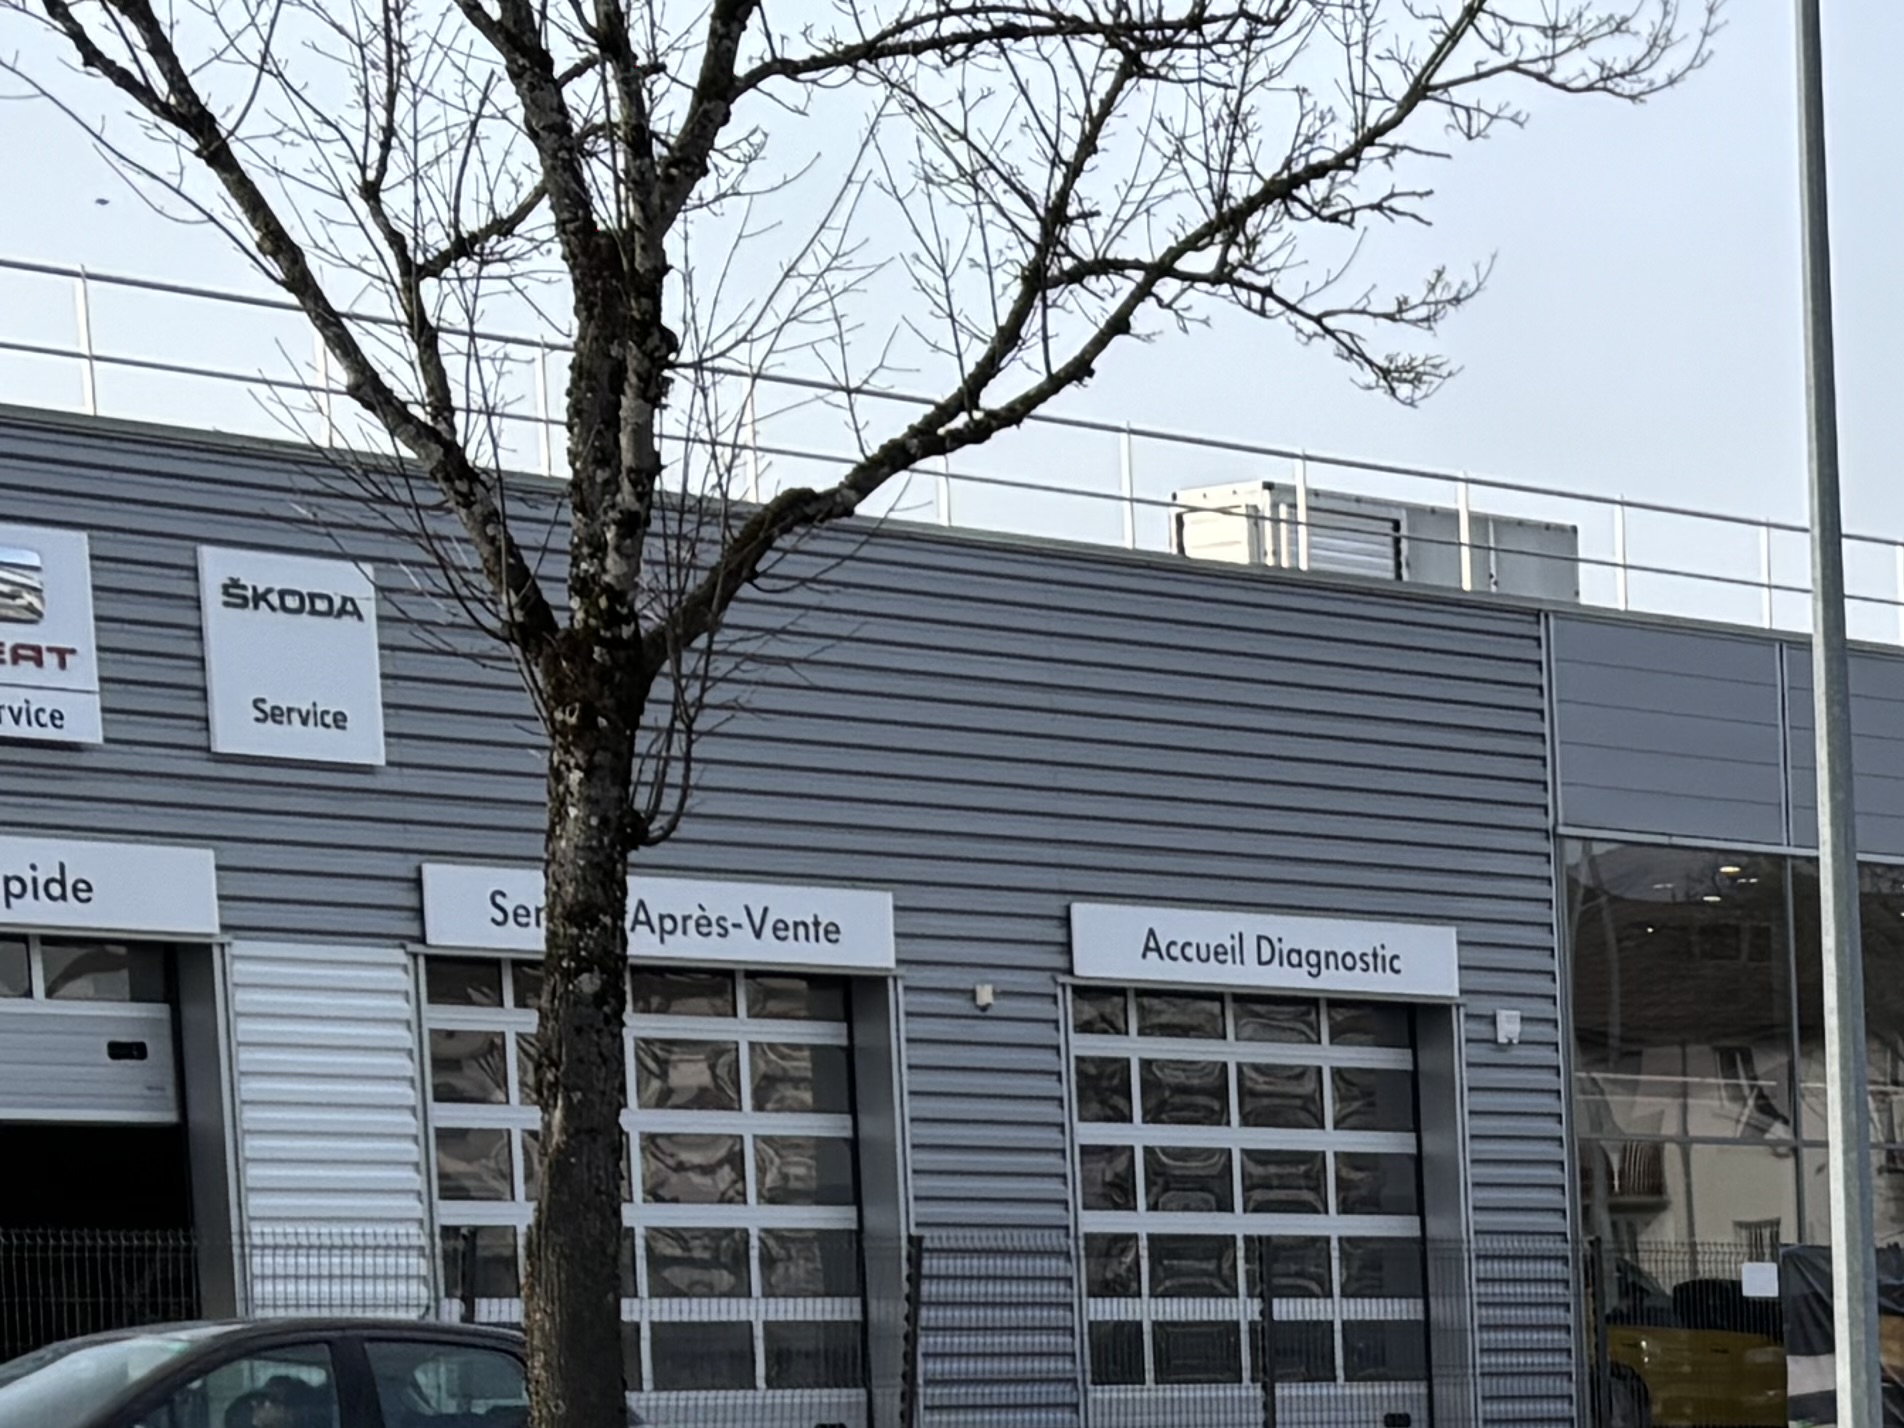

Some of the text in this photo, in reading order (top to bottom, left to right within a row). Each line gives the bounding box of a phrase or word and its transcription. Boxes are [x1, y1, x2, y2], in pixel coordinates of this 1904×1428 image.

[221, 577, 365, 622] ŠKODA
[252, 698, 348, 730] Service
[629, 898, 842, 945] Après-Vente
[1141, 927, 1403, 979] Accueil Diagnostic
